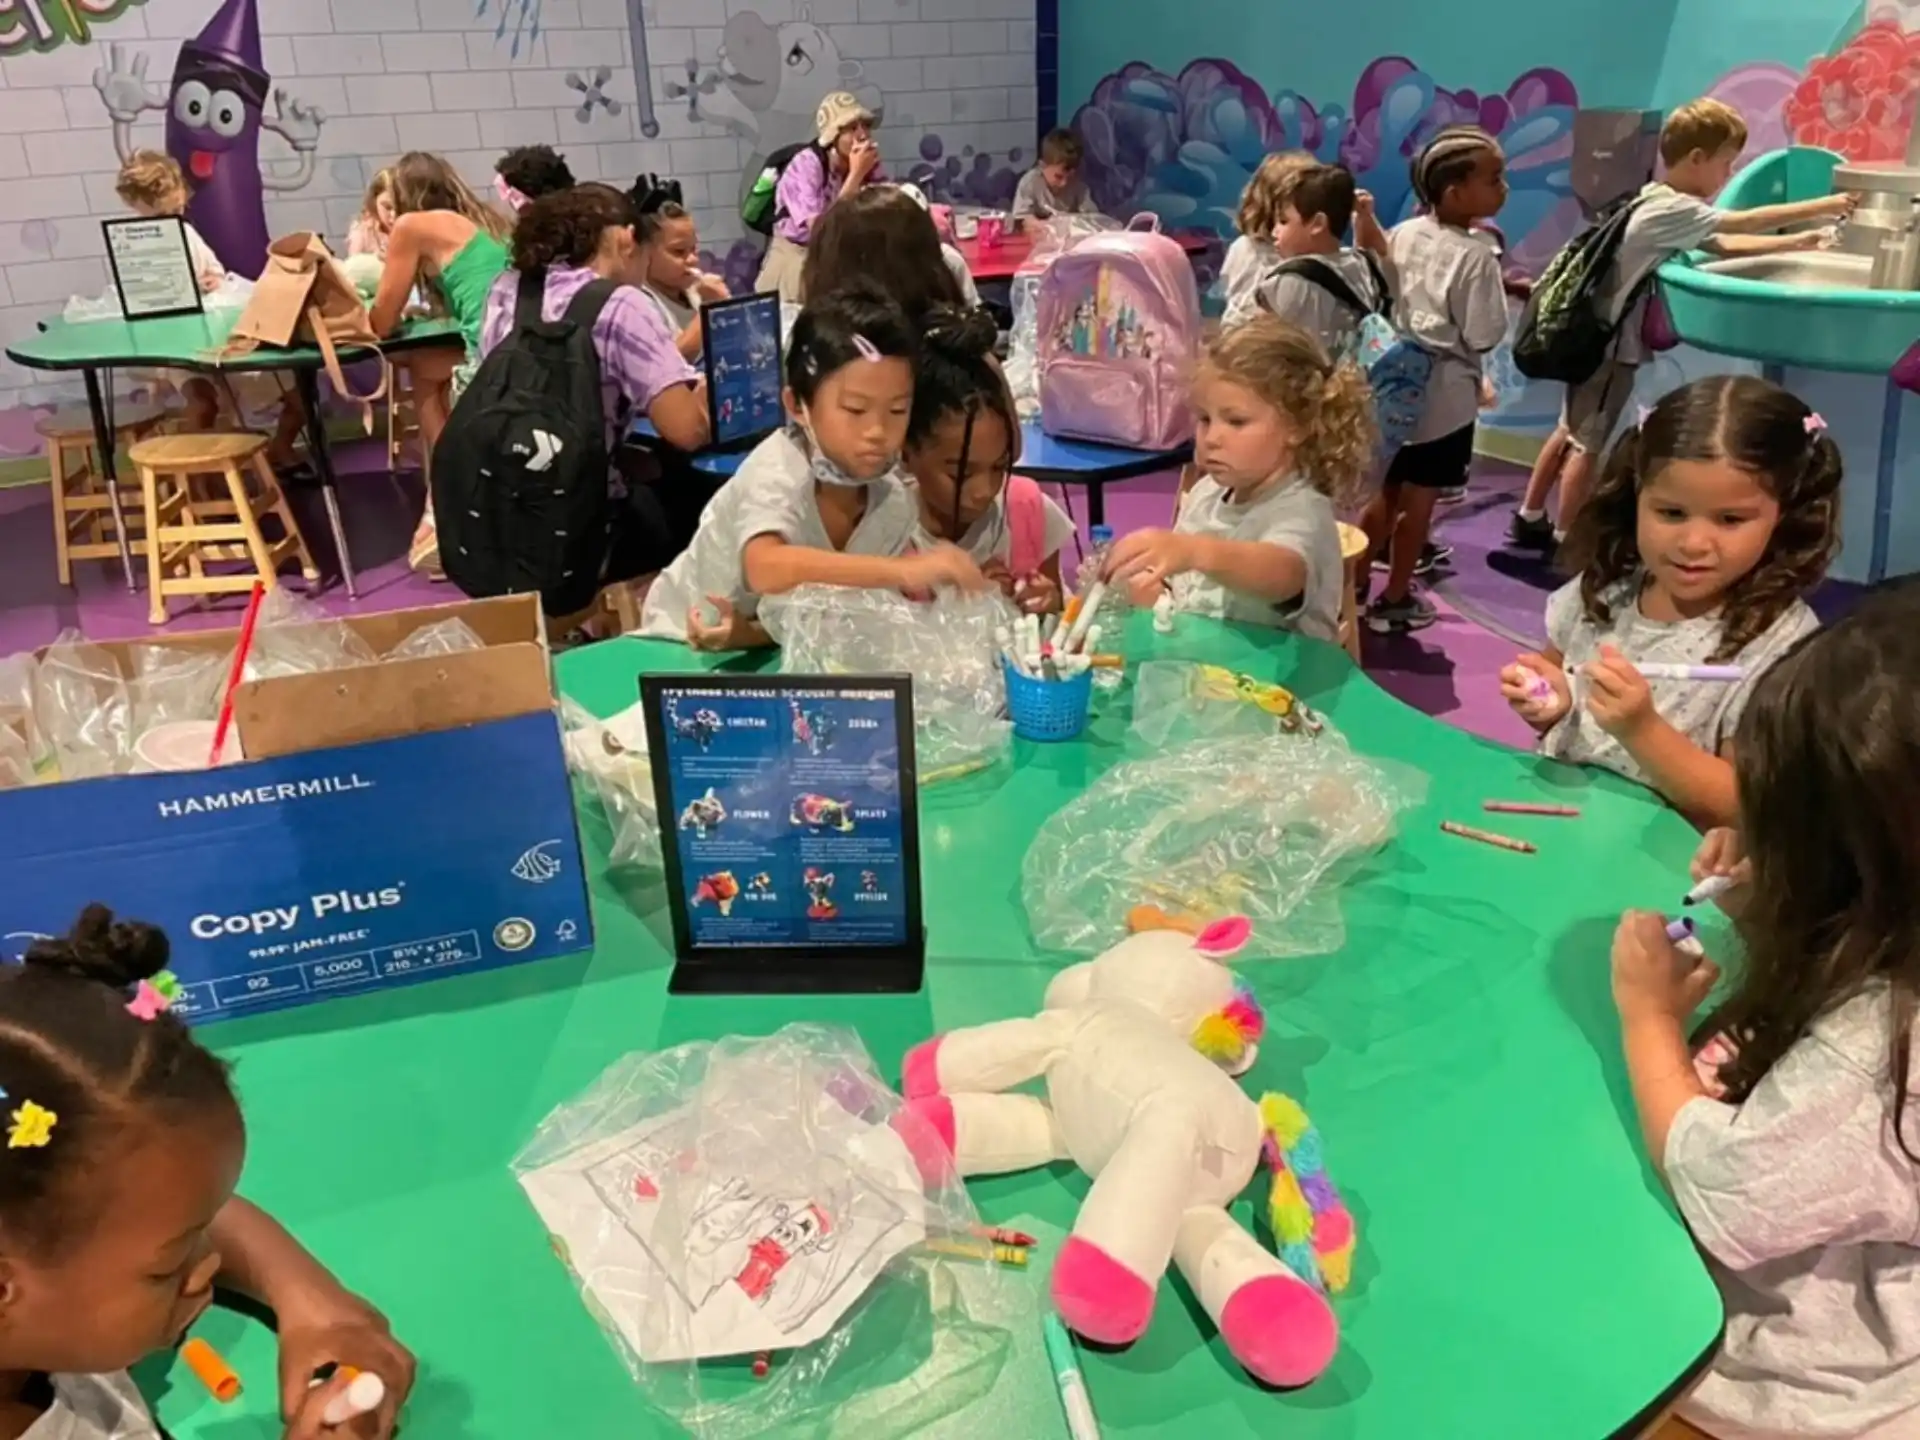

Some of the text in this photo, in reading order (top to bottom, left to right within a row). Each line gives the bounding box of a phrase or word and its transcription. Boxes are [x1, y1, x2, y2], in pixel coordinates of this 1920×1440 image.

[158, 773, 371, 818] HAMMERMILL
[190, 905, 300, 939] Copy
[312, 957, 364, 977] 5,000
[247, 976, 271, 990] 92
